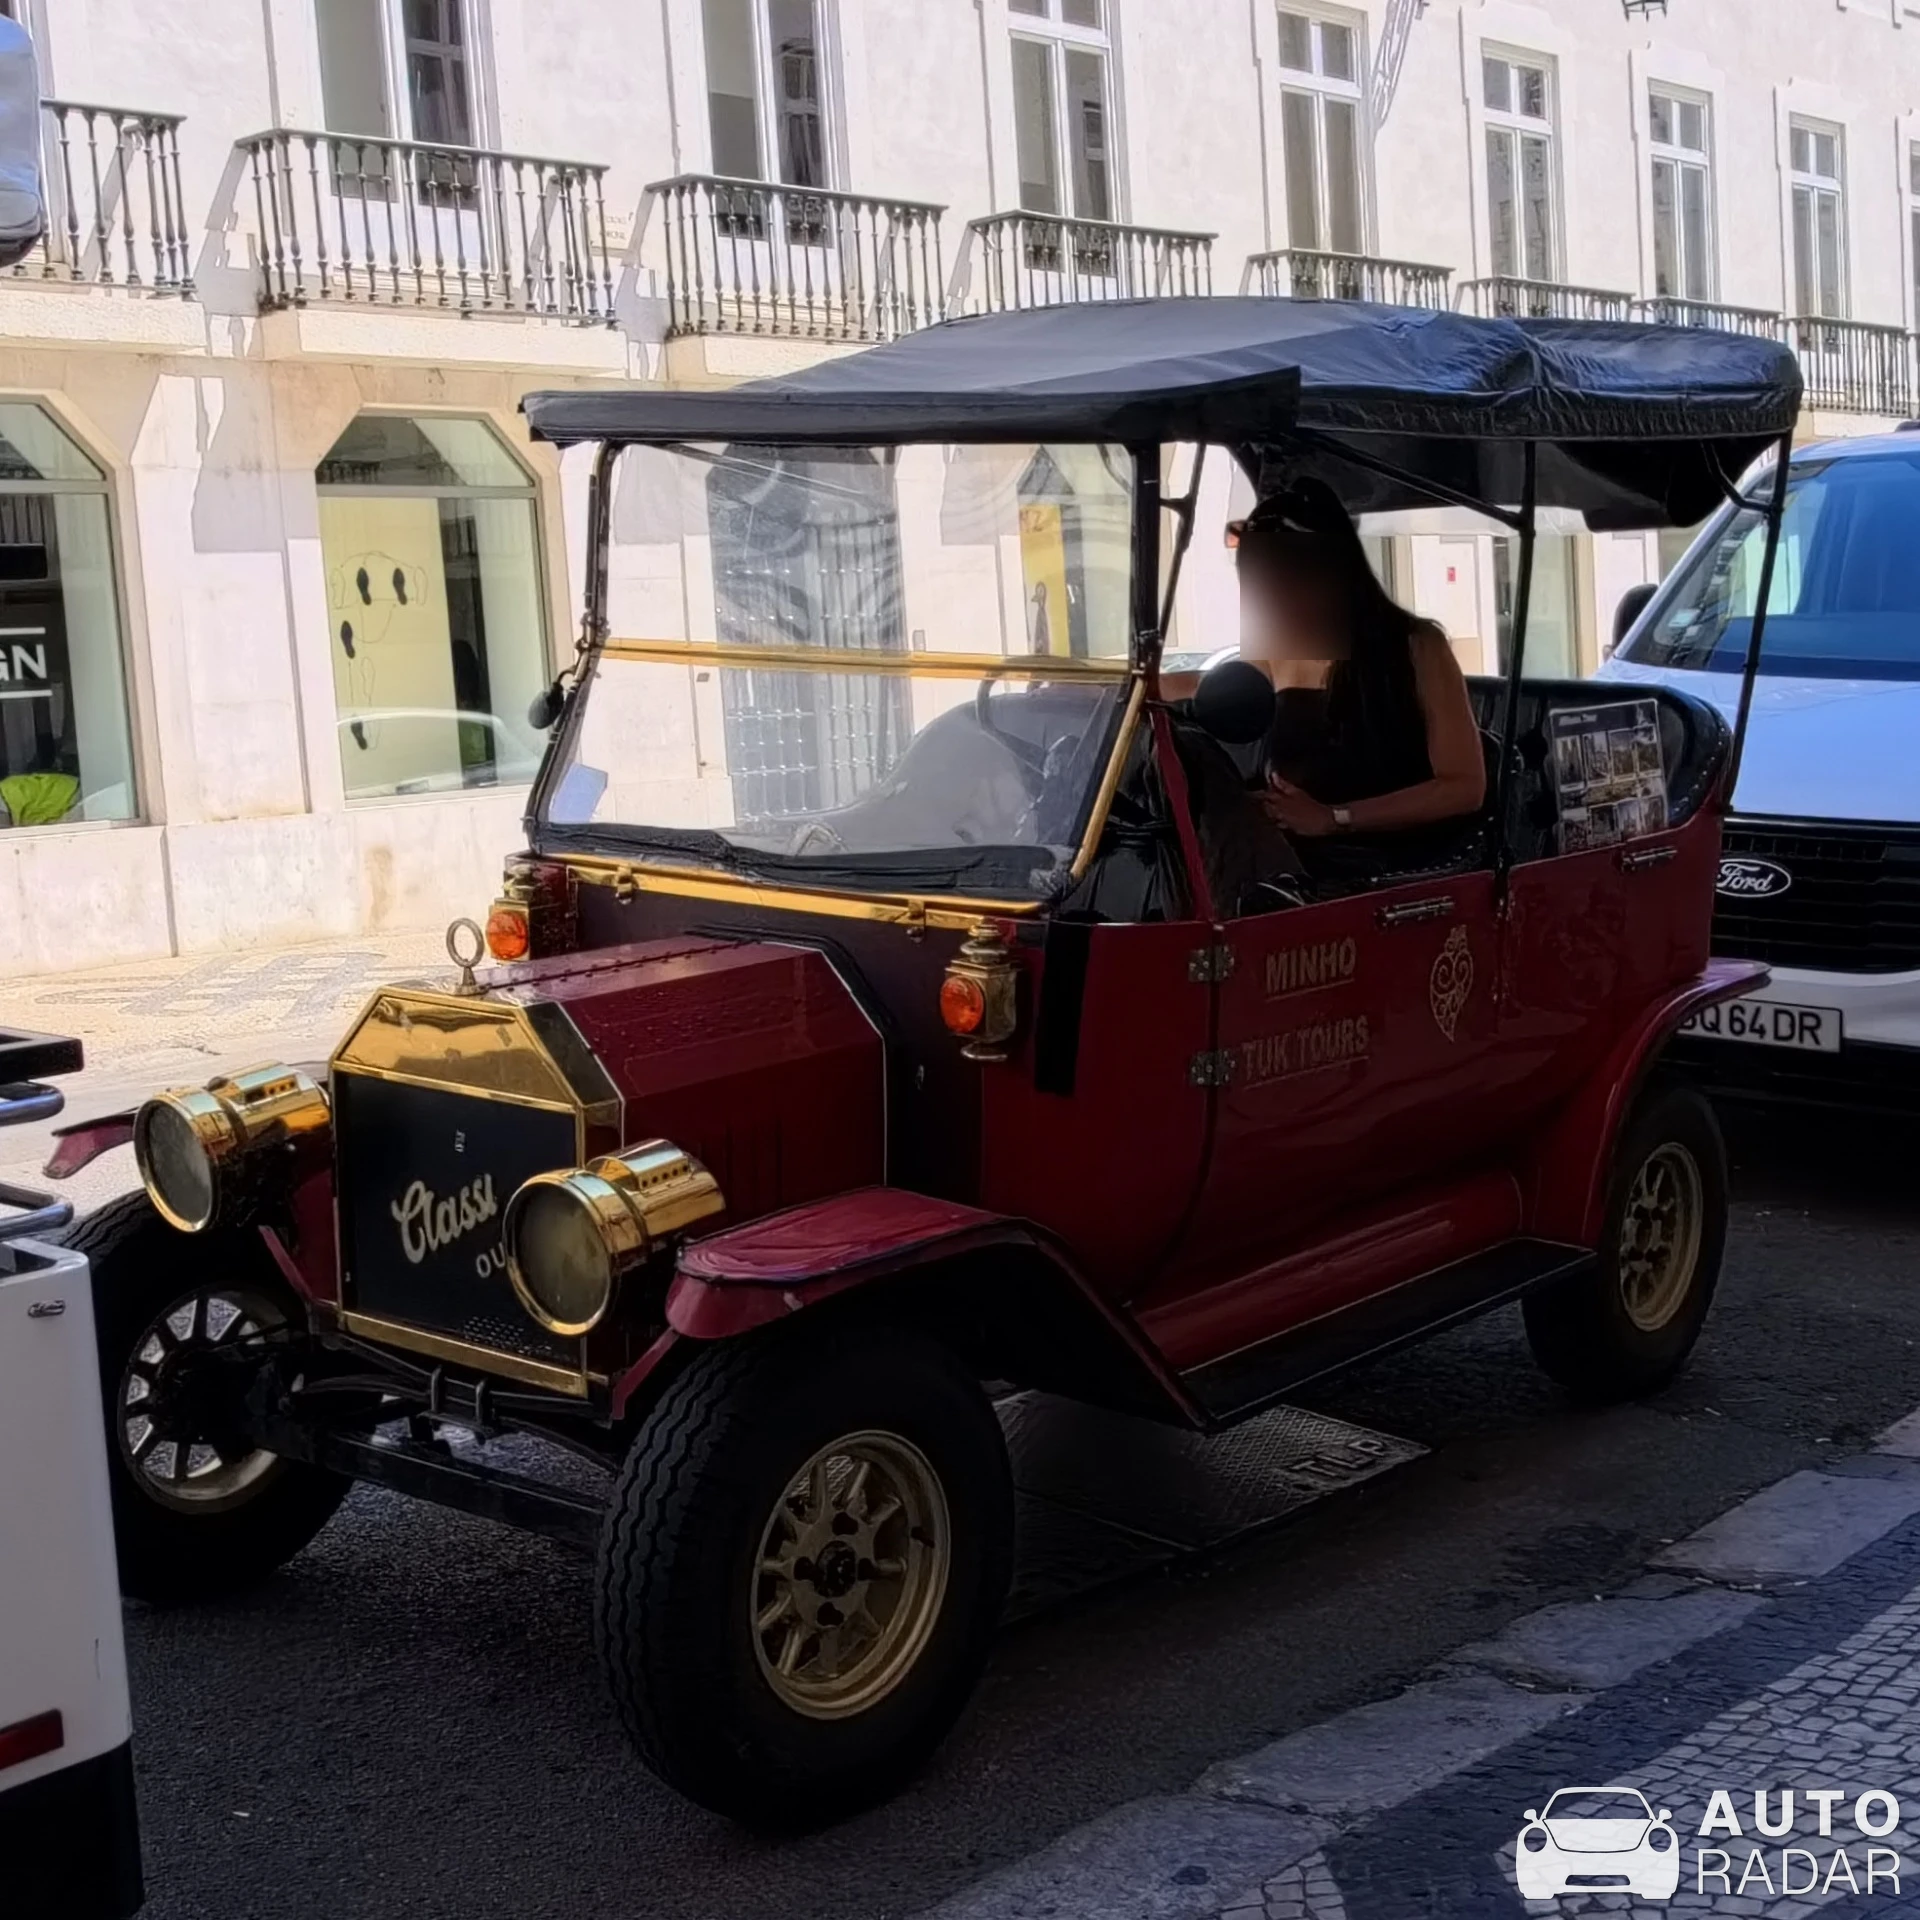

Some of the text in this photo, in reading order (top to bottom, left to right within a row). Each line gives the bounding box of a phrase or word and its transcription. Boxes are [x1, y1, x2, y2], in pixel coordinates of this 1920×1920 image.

[0, 643, 48, 682] N
[1716, 863, 1774, 891] Ford
[1264, 936, 1357, 995] MINHO
[1729, 1004, 1766, 1039] 64
[1773, 1009, 1822, 1046] DR
[1241, 1014, 1370, 1081] TUK TOURS
